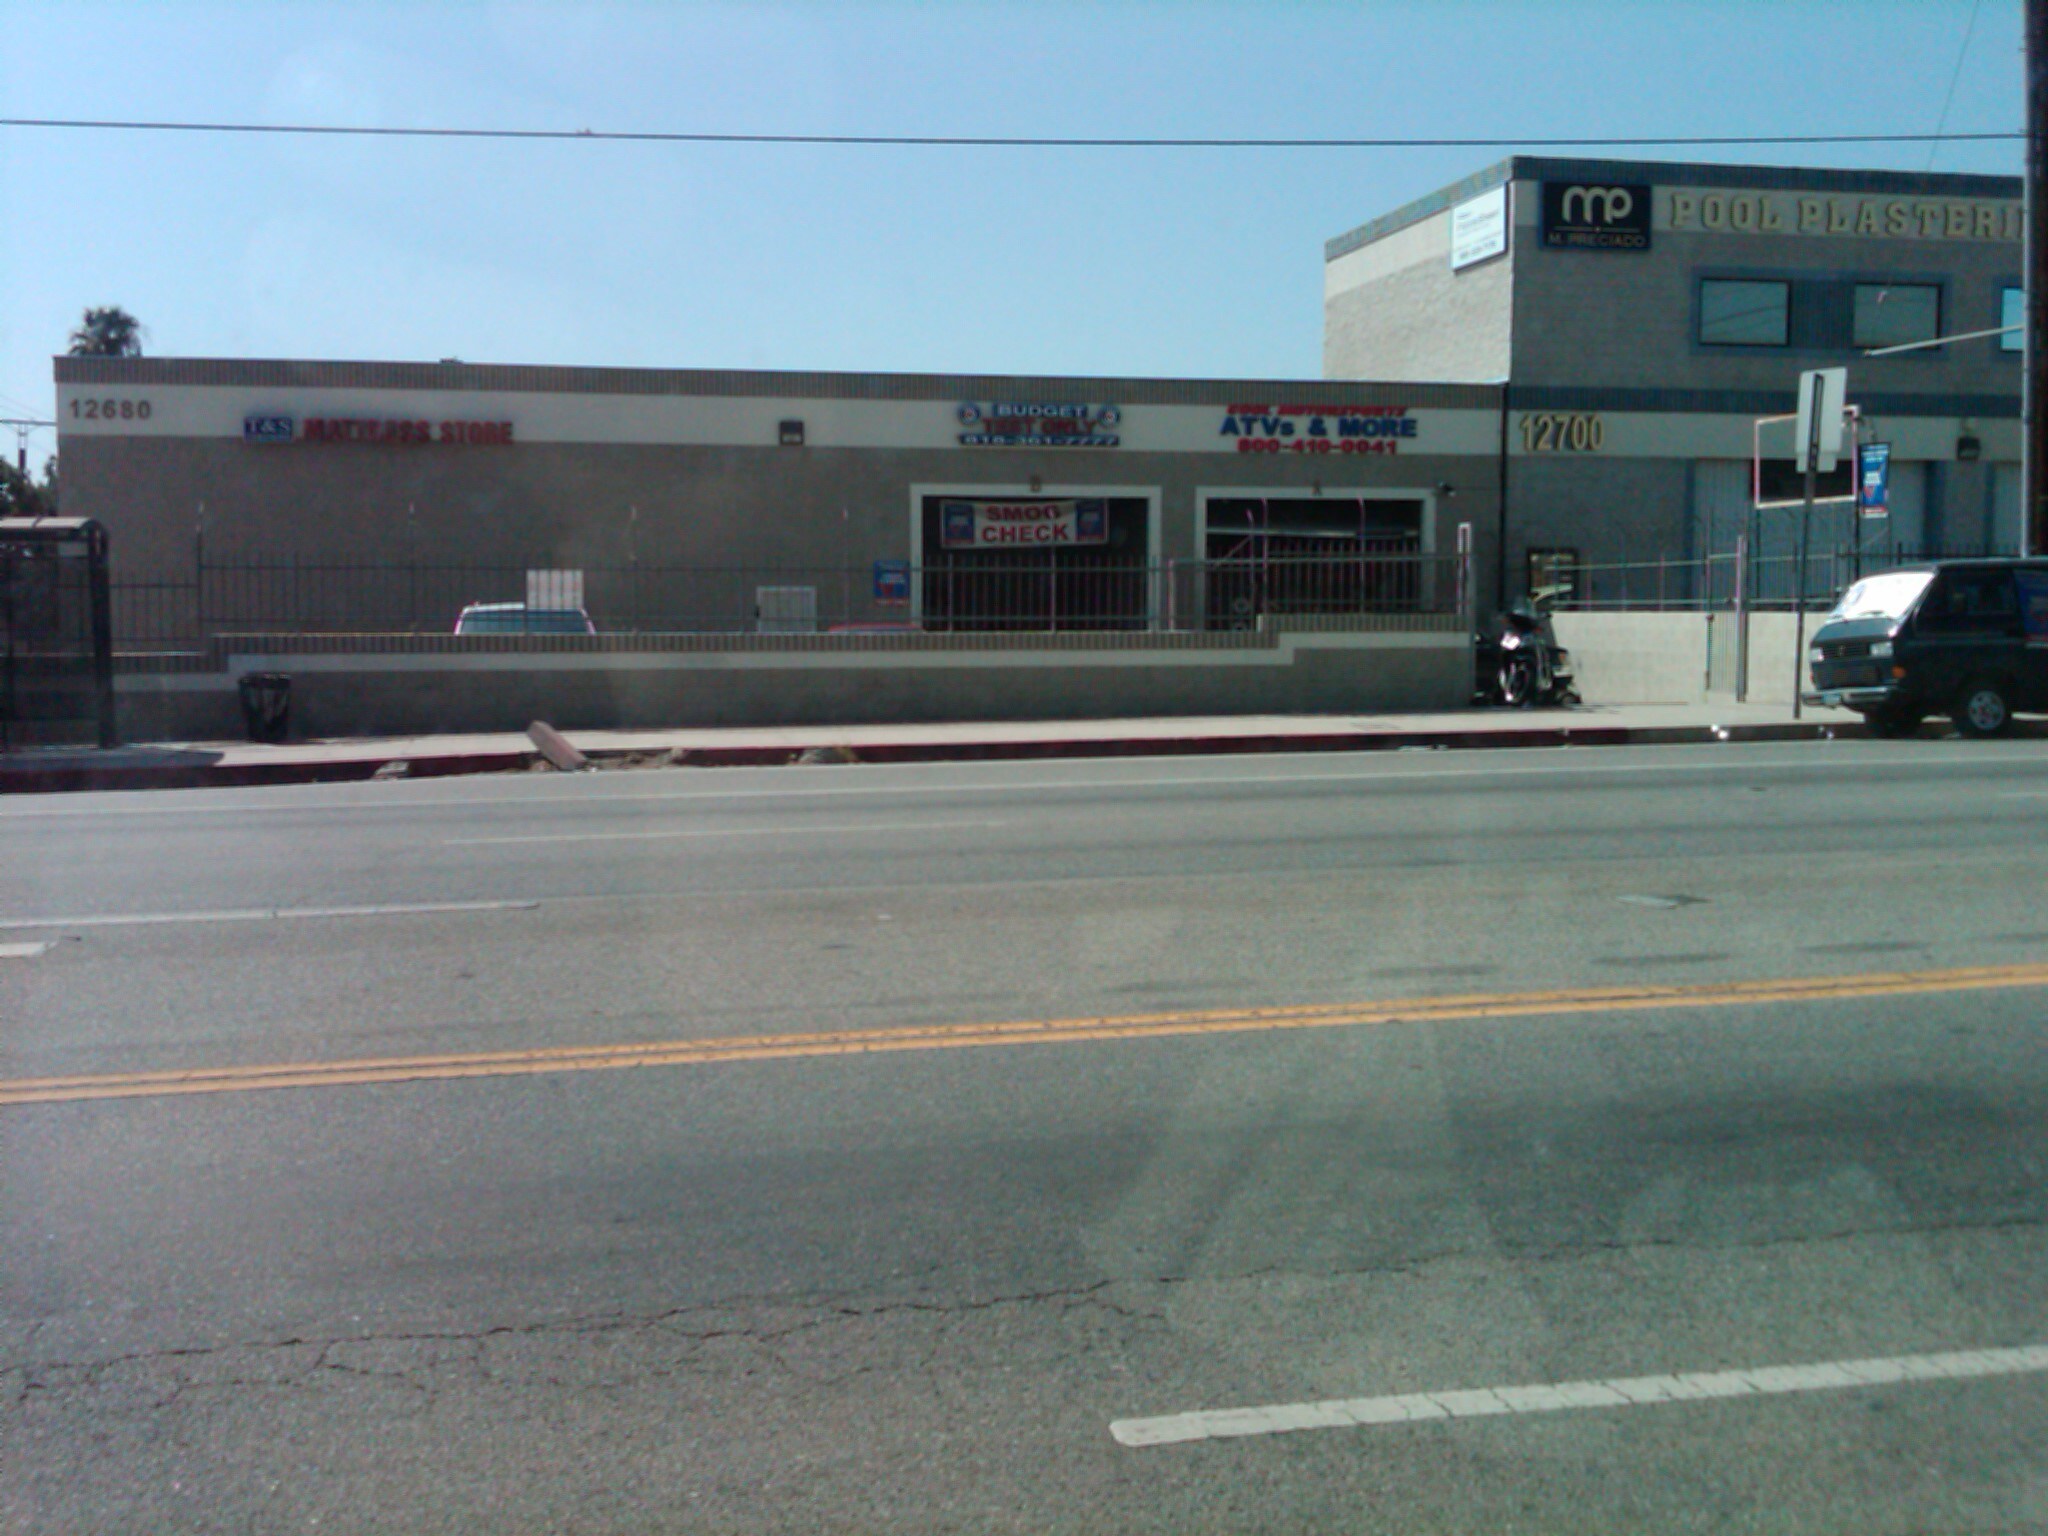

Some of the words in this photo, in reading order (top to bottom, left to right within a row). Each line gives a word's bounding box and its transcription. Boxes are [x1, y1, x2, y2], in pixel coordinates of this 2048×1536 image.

[1671, 193, 1781, 231] POOL
[1798, 197, 2024, 239] PLASTERI
[69, 399, 152, 420] 12680
[996, 404, 1087, 417] BUDGET
[440, 421, 514, 445] STORE
[981, 417, 1036, 434] TEST
[1041, 418, 1099, 435] ONLY
[1220, 416, 1295, 436] ATVs
[1307, 417, 1328, 436] &
[1338, 417, 1418, 437] MORE
[1520, 414, 1603, 450] 12700
[985, 504, 1060, 521] SMOG
[981, 522, 1068, 543] CHECK
